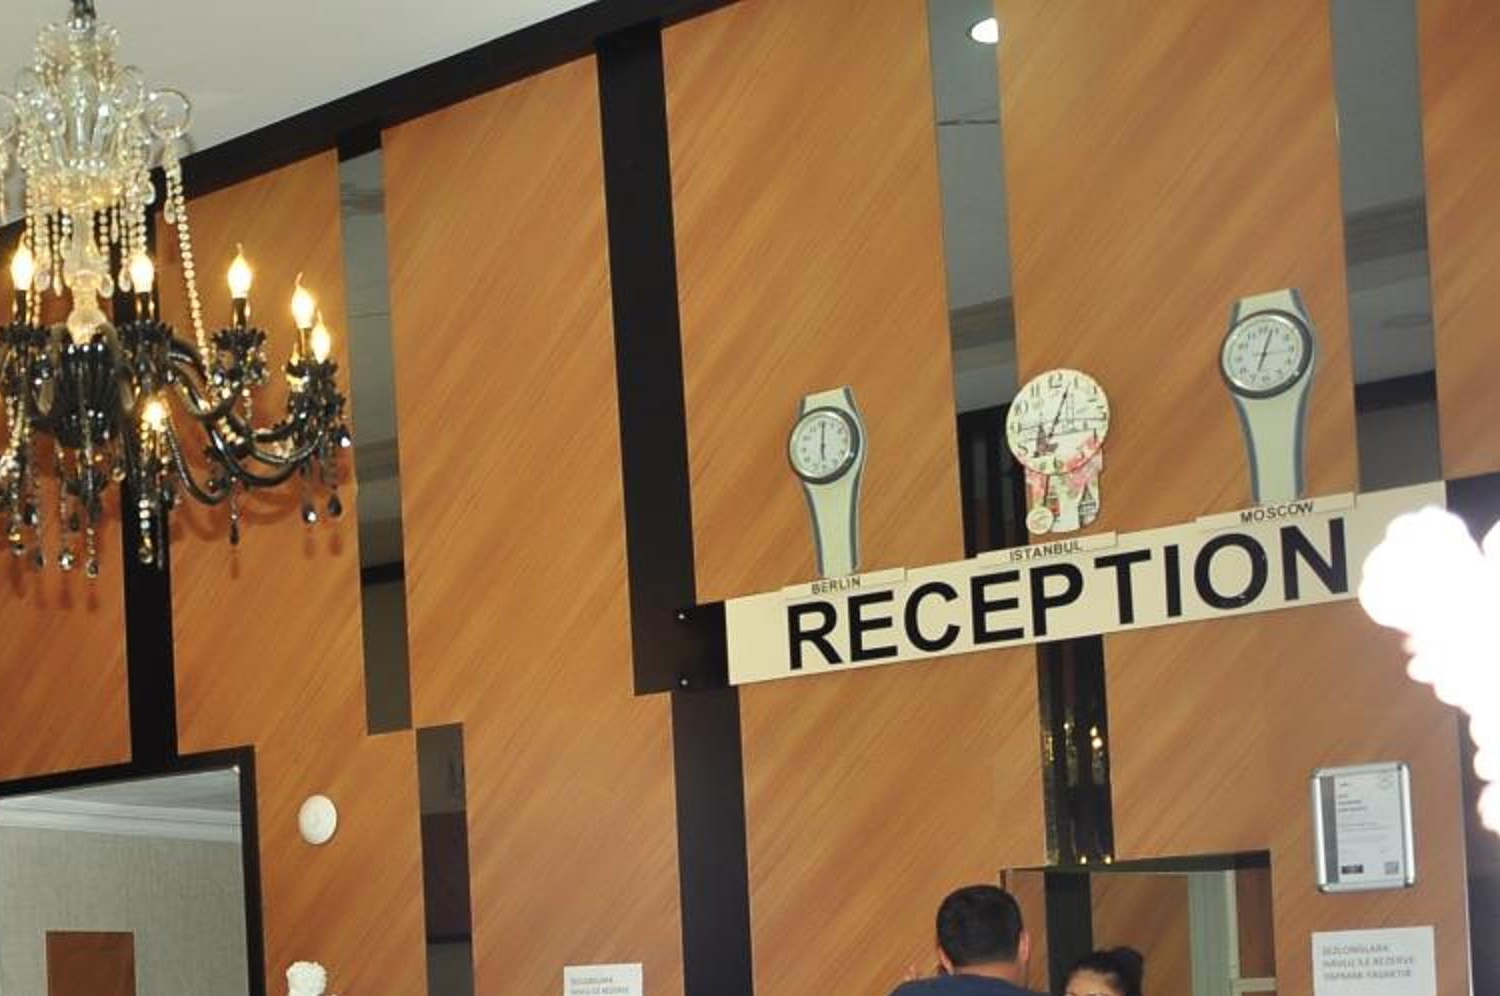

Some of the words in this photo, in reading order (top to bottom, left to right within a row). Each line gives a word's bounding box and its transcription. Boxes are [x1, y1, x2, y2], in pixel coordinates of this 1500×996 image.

[1240, 501, 1314, 522] MOSCOW
[1009, 540, 1082, 561] ISTANBUL
[787, 516, 1349, 671] RECEPTION
[811, 578, 861, 595] BERLIN
